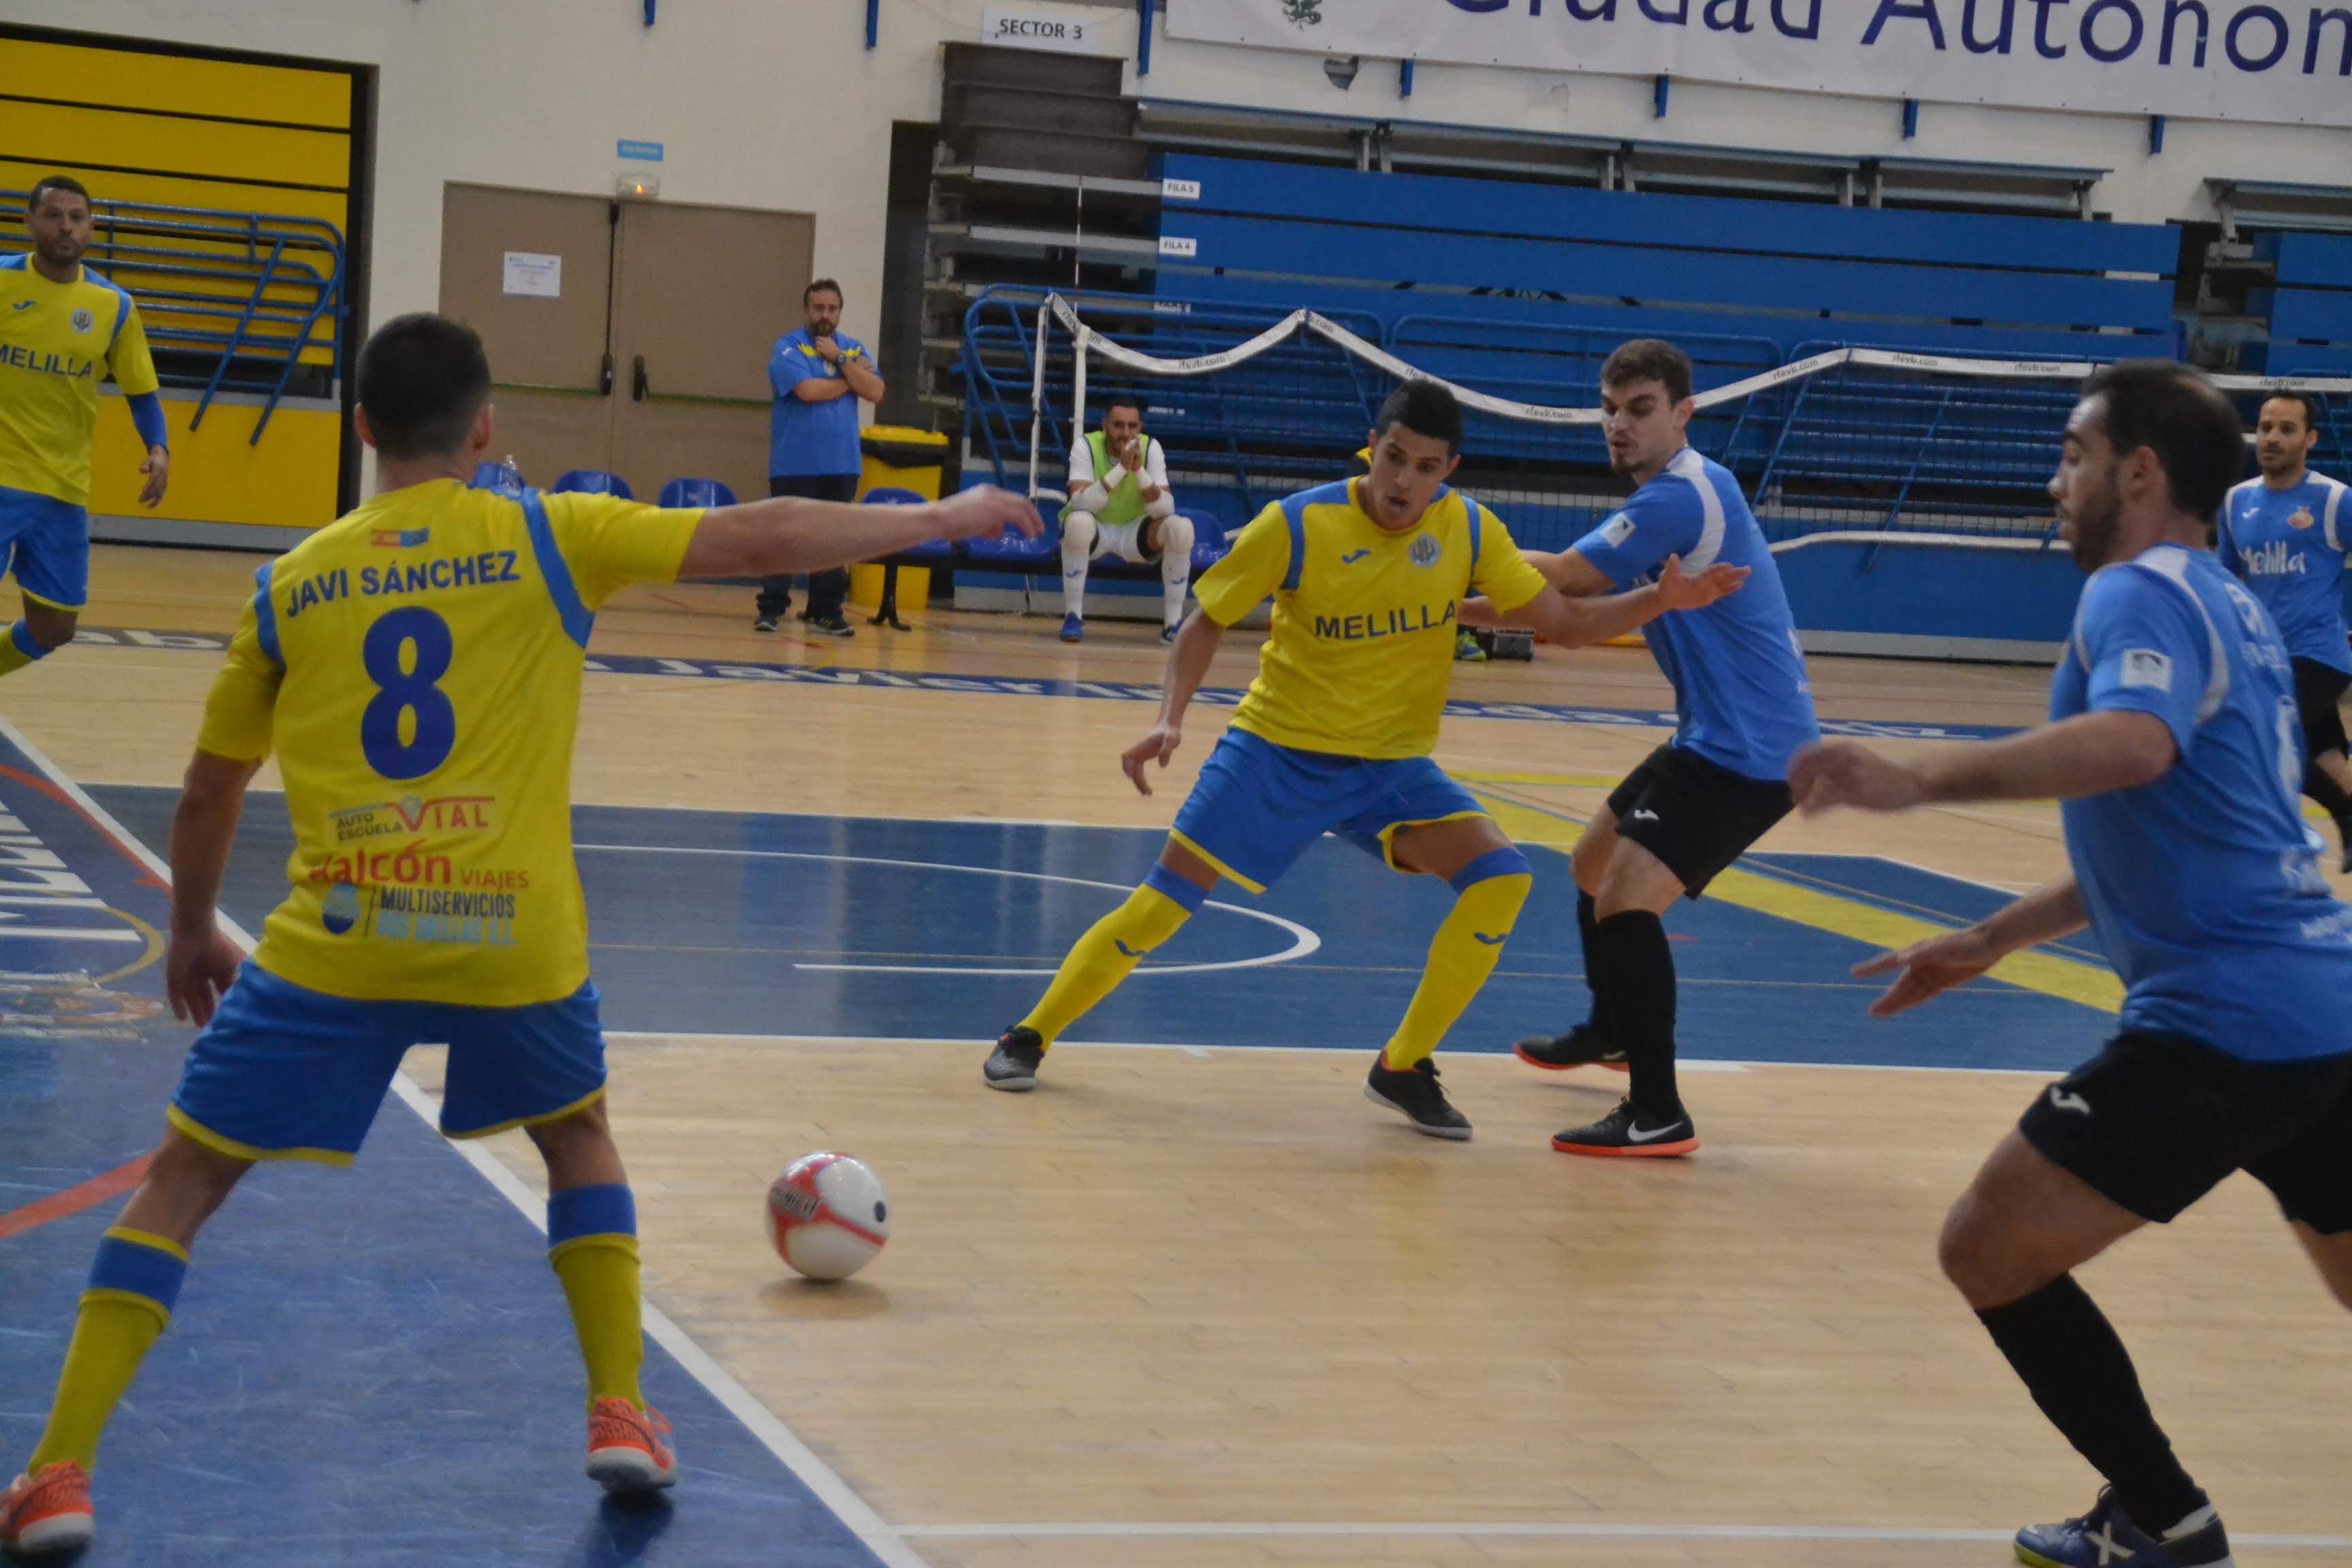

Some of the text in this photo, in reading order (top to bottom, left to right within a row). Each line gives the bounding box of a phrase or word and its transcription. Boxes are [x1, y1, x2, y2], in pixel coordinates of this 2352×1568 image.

[999, 18, 1083, 39] SECTOR 3
[1167, 182, 1187, 193] FILA
[1164, 240, 1190, 250] FILA 4
[286, 550, 521, 617] JAVI SÁNCHEZ
[1315, 599, 1456, 640] MELILLA
[360, 604, 455, 779] 8
[337, 812, 374, 829] AUTO
[338, 822, 403, 841] ESCUELA
[460, 868, 529, 891] VIAJES
[380, 885, 515, 919] MULTISERVICIOS
